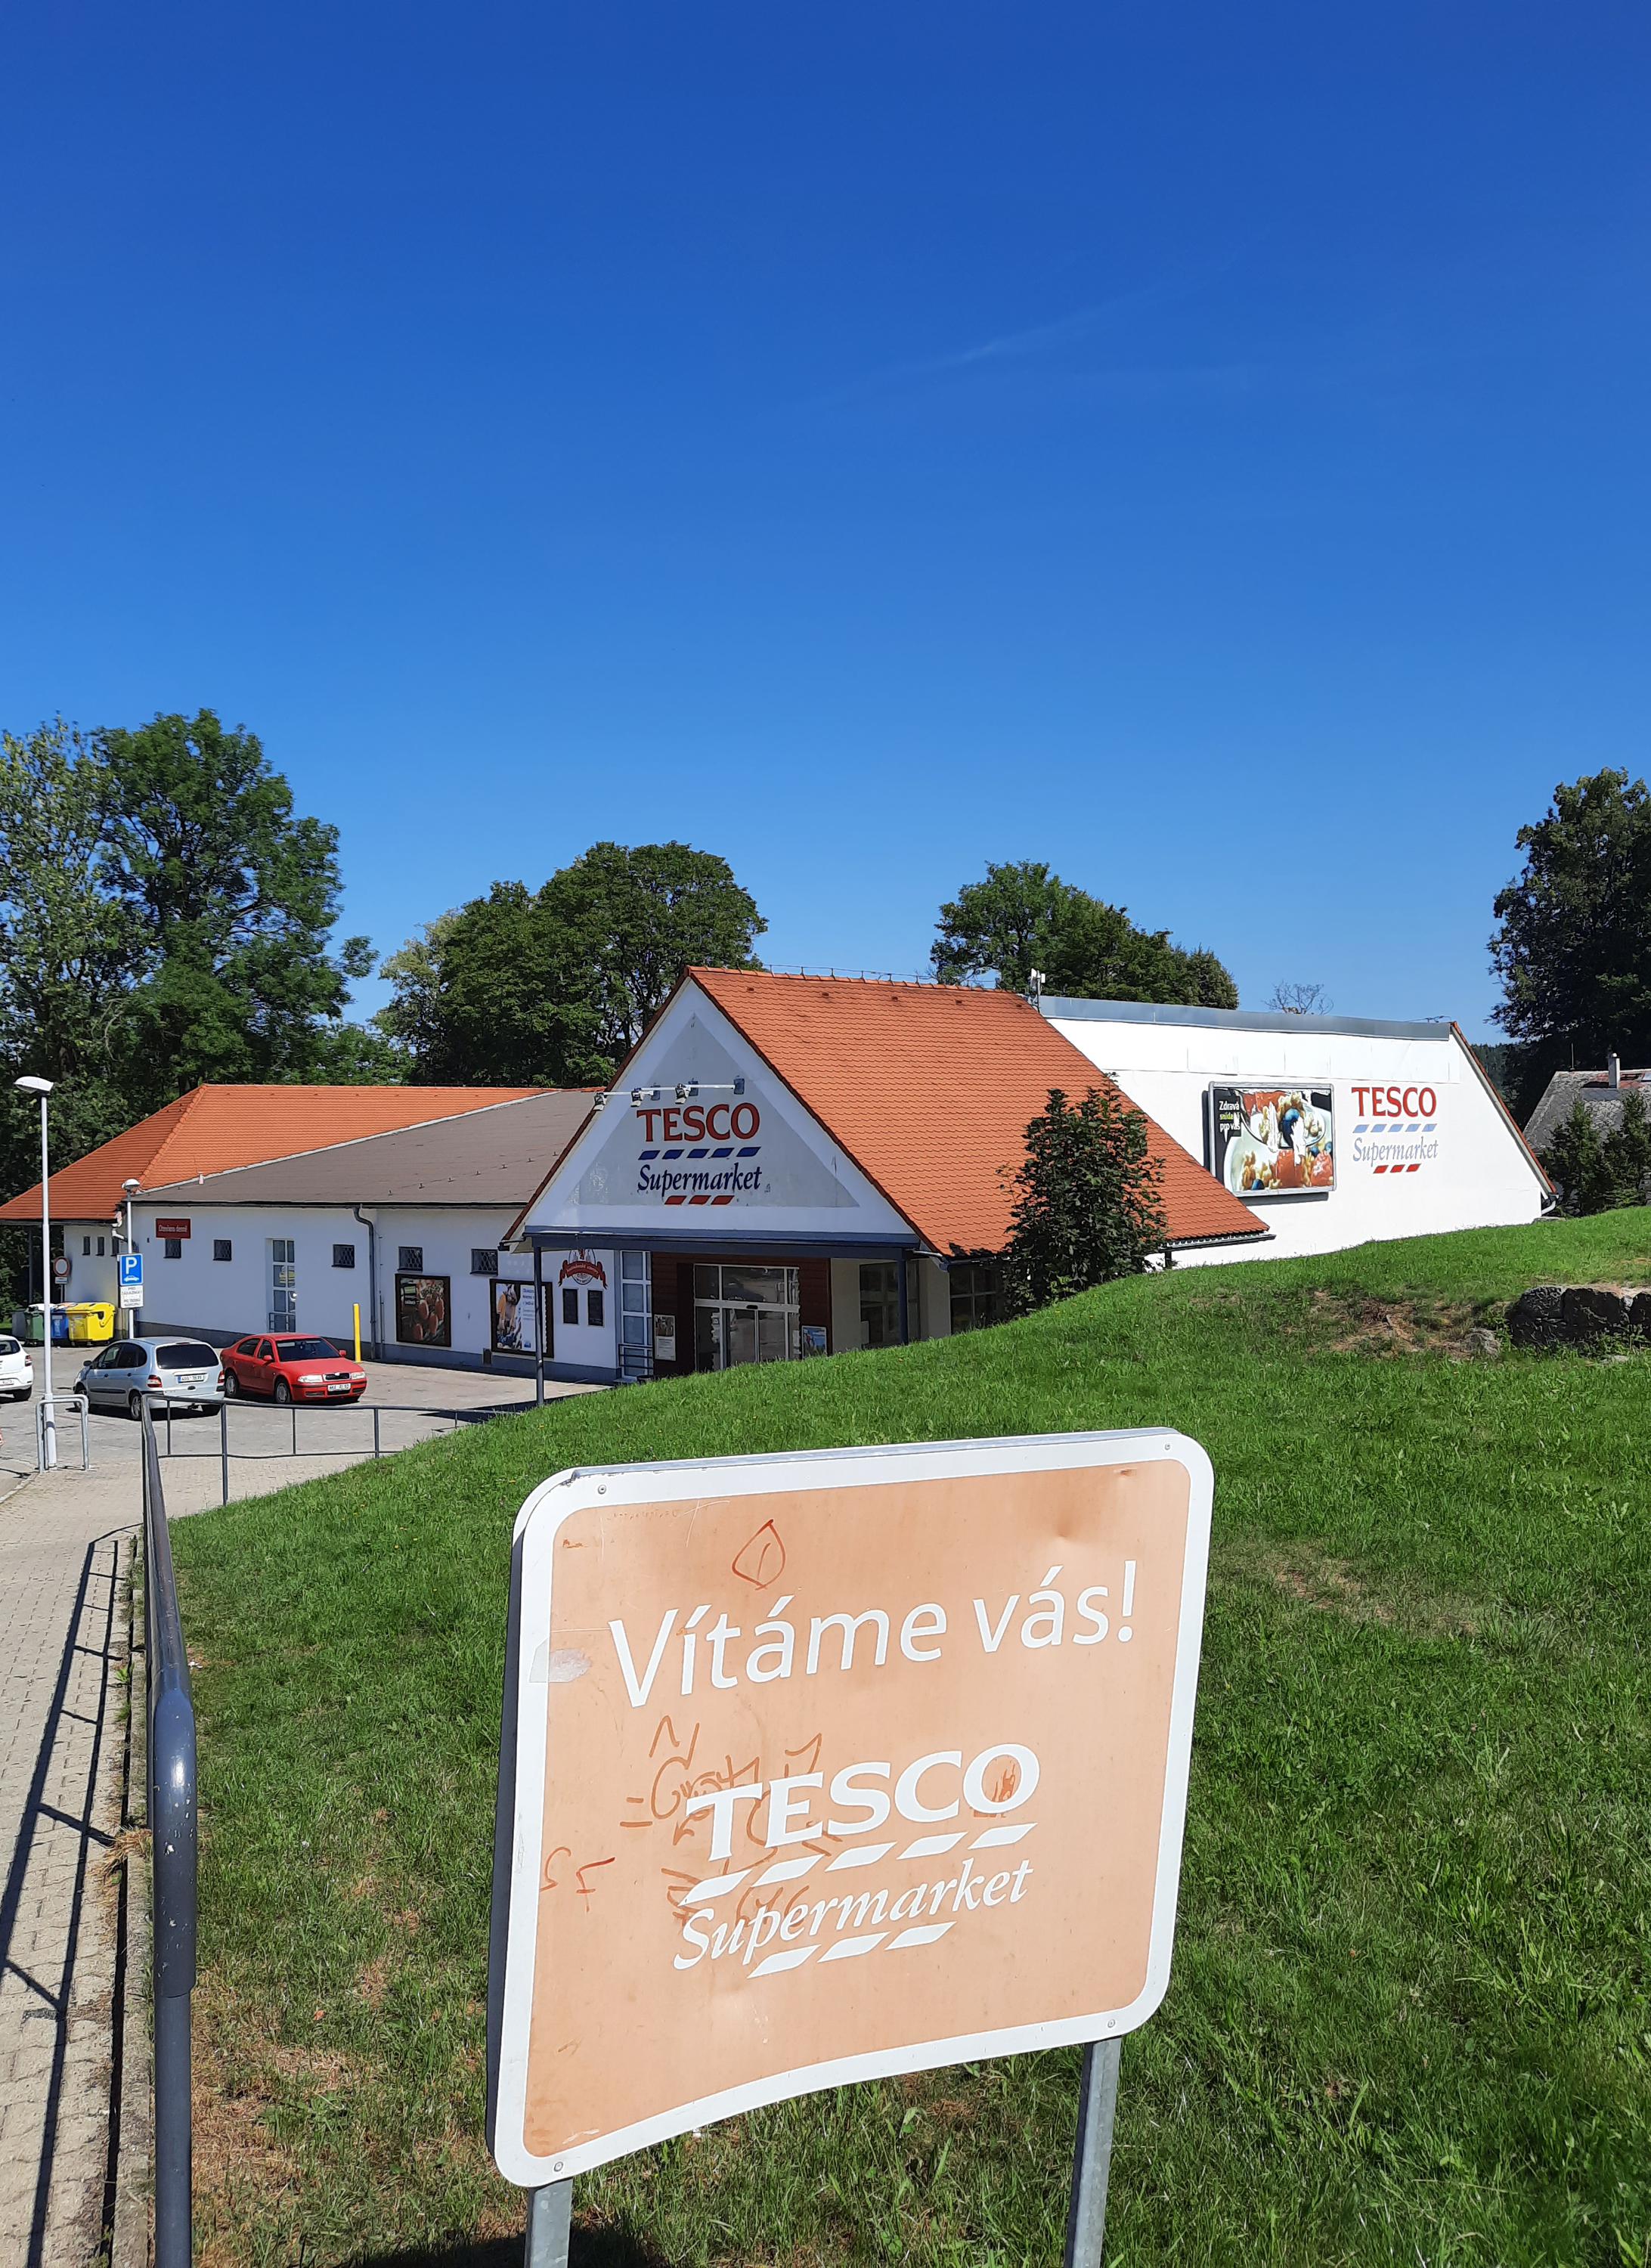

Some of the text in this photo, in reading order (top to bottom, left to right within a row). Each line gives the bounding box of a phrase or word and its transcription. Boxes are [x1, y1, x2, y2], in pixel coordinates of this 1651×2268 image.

[1219, 1100, 1240, 1111] Zdravá
[1352, 1087, 1437, 1117] TESCO
[637, 1102, 760, 1142] TESCO
[1352, 1136, 1439, 1167] Supermarket
[637, 1162, 763, 1197] Supermarket
[125, 1256, 138, 1275] P
[608, 1560, 1137, 1708] Vítáme vás!
[686, 1743, 1040, 1862] TESCO
[674, 1857, 1033, 1970] Supermarket
